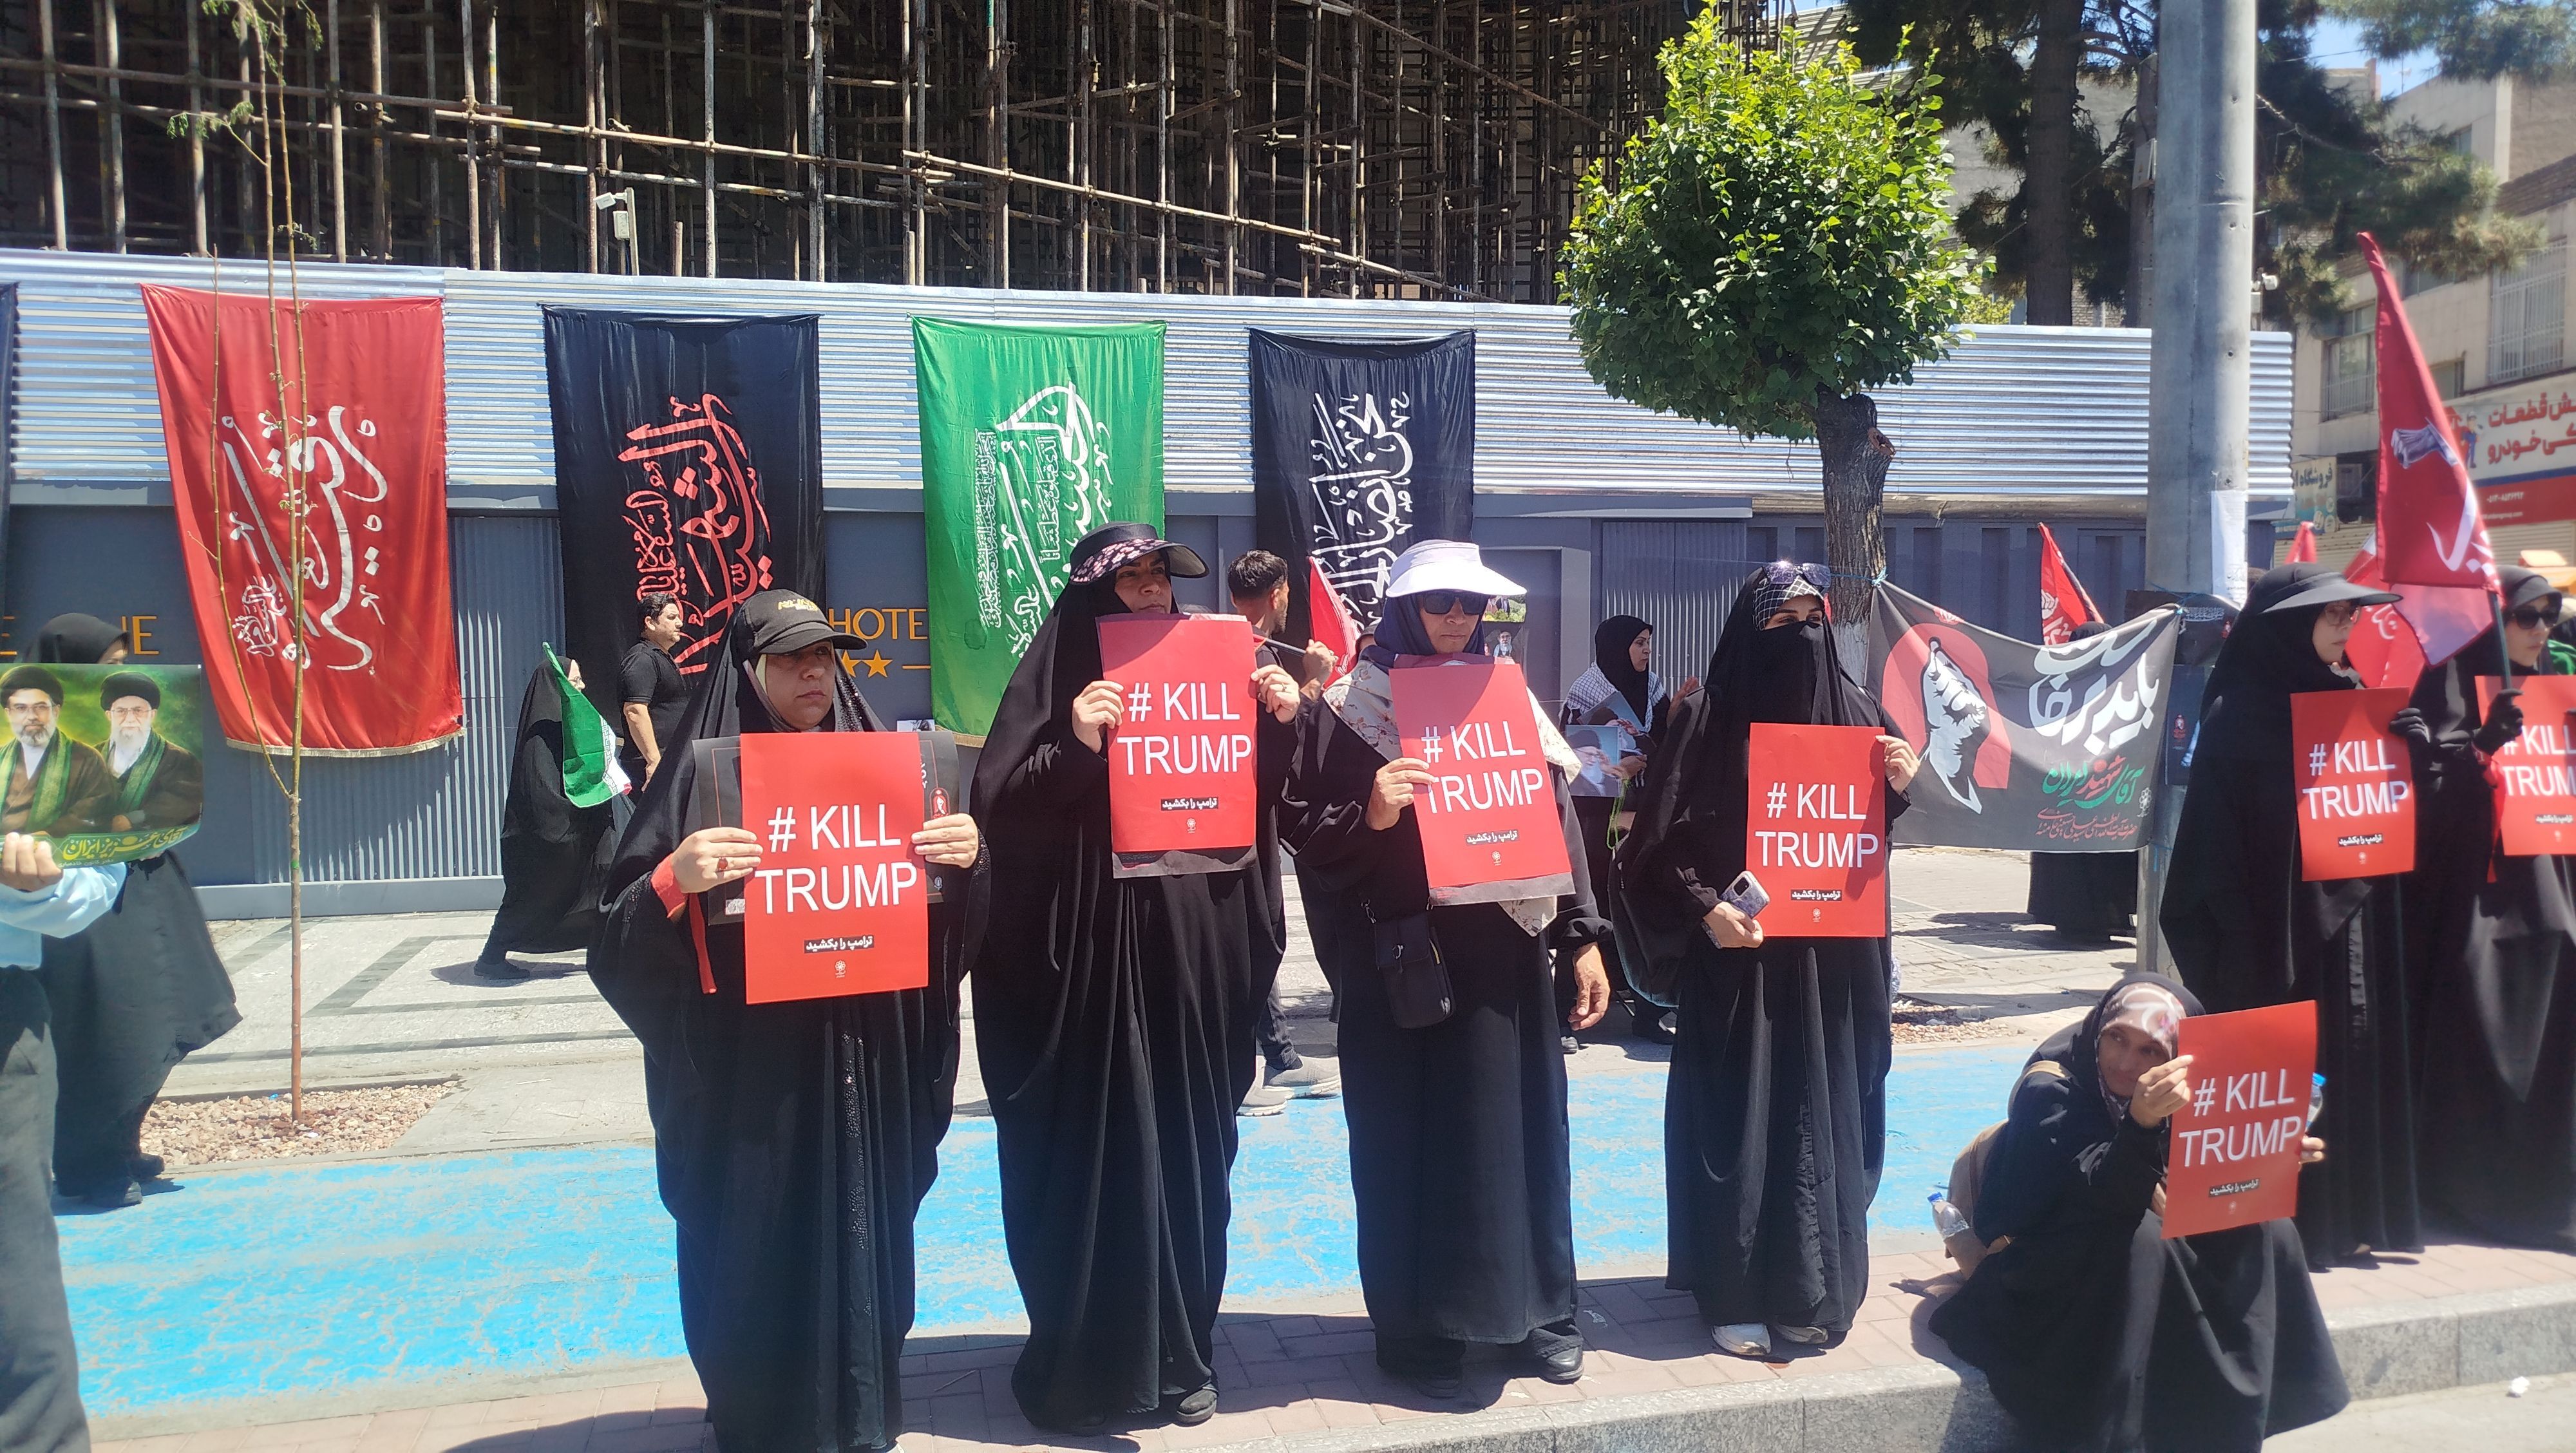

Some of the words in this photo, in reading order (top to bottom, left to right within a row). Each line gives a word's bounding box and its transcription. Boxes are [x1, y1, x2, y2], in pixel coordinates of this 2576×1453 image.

[2488, 392, 2547, 427] قطعات
[1336, 393, 1413, 479] نحن
[2488, 430, 2541, 464] خودرو
[2300, 462, 2333, 489] فروشگاه
[1128, 682, 1152, 722] #
[1164, 682, 1240, 721] KILL
[2092, 652, 2159, 750] باید
[1421, 726, 1444, 763] #
[1450, 721, 1526, 761] KILL
[2521, 725, 2576, 755] KILL
[1117, 734, 1251, 775] TRUMP
[2309, 743, 2327, 776] #
[2334, 739, 2395, 775] KILL
[1427, 768, 1543, 814] TRUMP
[2041, 760, 2088, 797] ایران
[2502, 765, 2576, 796] TRUM
[1162, 799, 1189, 810] بکشید
[1189, 798, 1196, 809] را
[1196, 797, 1217, 810] ترامپ
[1766, 783, 1787, 819] #
[1797, 783, 1866, 820] KILL
[2302, 780, 2408, 819] TRUMP
[768, 806, 796, 852] #
[811, 803, 901, 850] KILL
[1466, 833, 1492, 844] بکشید
[1491, 832, 1497, 842] را
[1498, 830, 1518, 843] ترامپ
[2339, 836, 2360, 846] بکشید
[2360, 835, 2365, 844] را
[2365, 834, 2382, 845] ترامپ
[62, 838, 100, 860] ایران
[1755, 831, 1879, 868] TRUMP
[754, 861, 918, 915] TRUMP
[1792, 890, 1816, 900] بکشید
[1816, 890, 1821, 900] را
[1822, 890, 1841, 901] ترامپ
[806, 938, 838, 952] بکشید
[839, 937, 846, 950] را
[847, 935, 873, 951] ترامپ
[2193, 1077, 2216, 1117] #
[2225, 1068, 2295, 1113] KILL
[2179, 1116, 2301, 1167] TRUMP
[2210, 1184, 2234, 1195] بکشید
[2235, 1182, 2240, 1192] را
[2240, 1179, 2259, 1192] ترامپ
